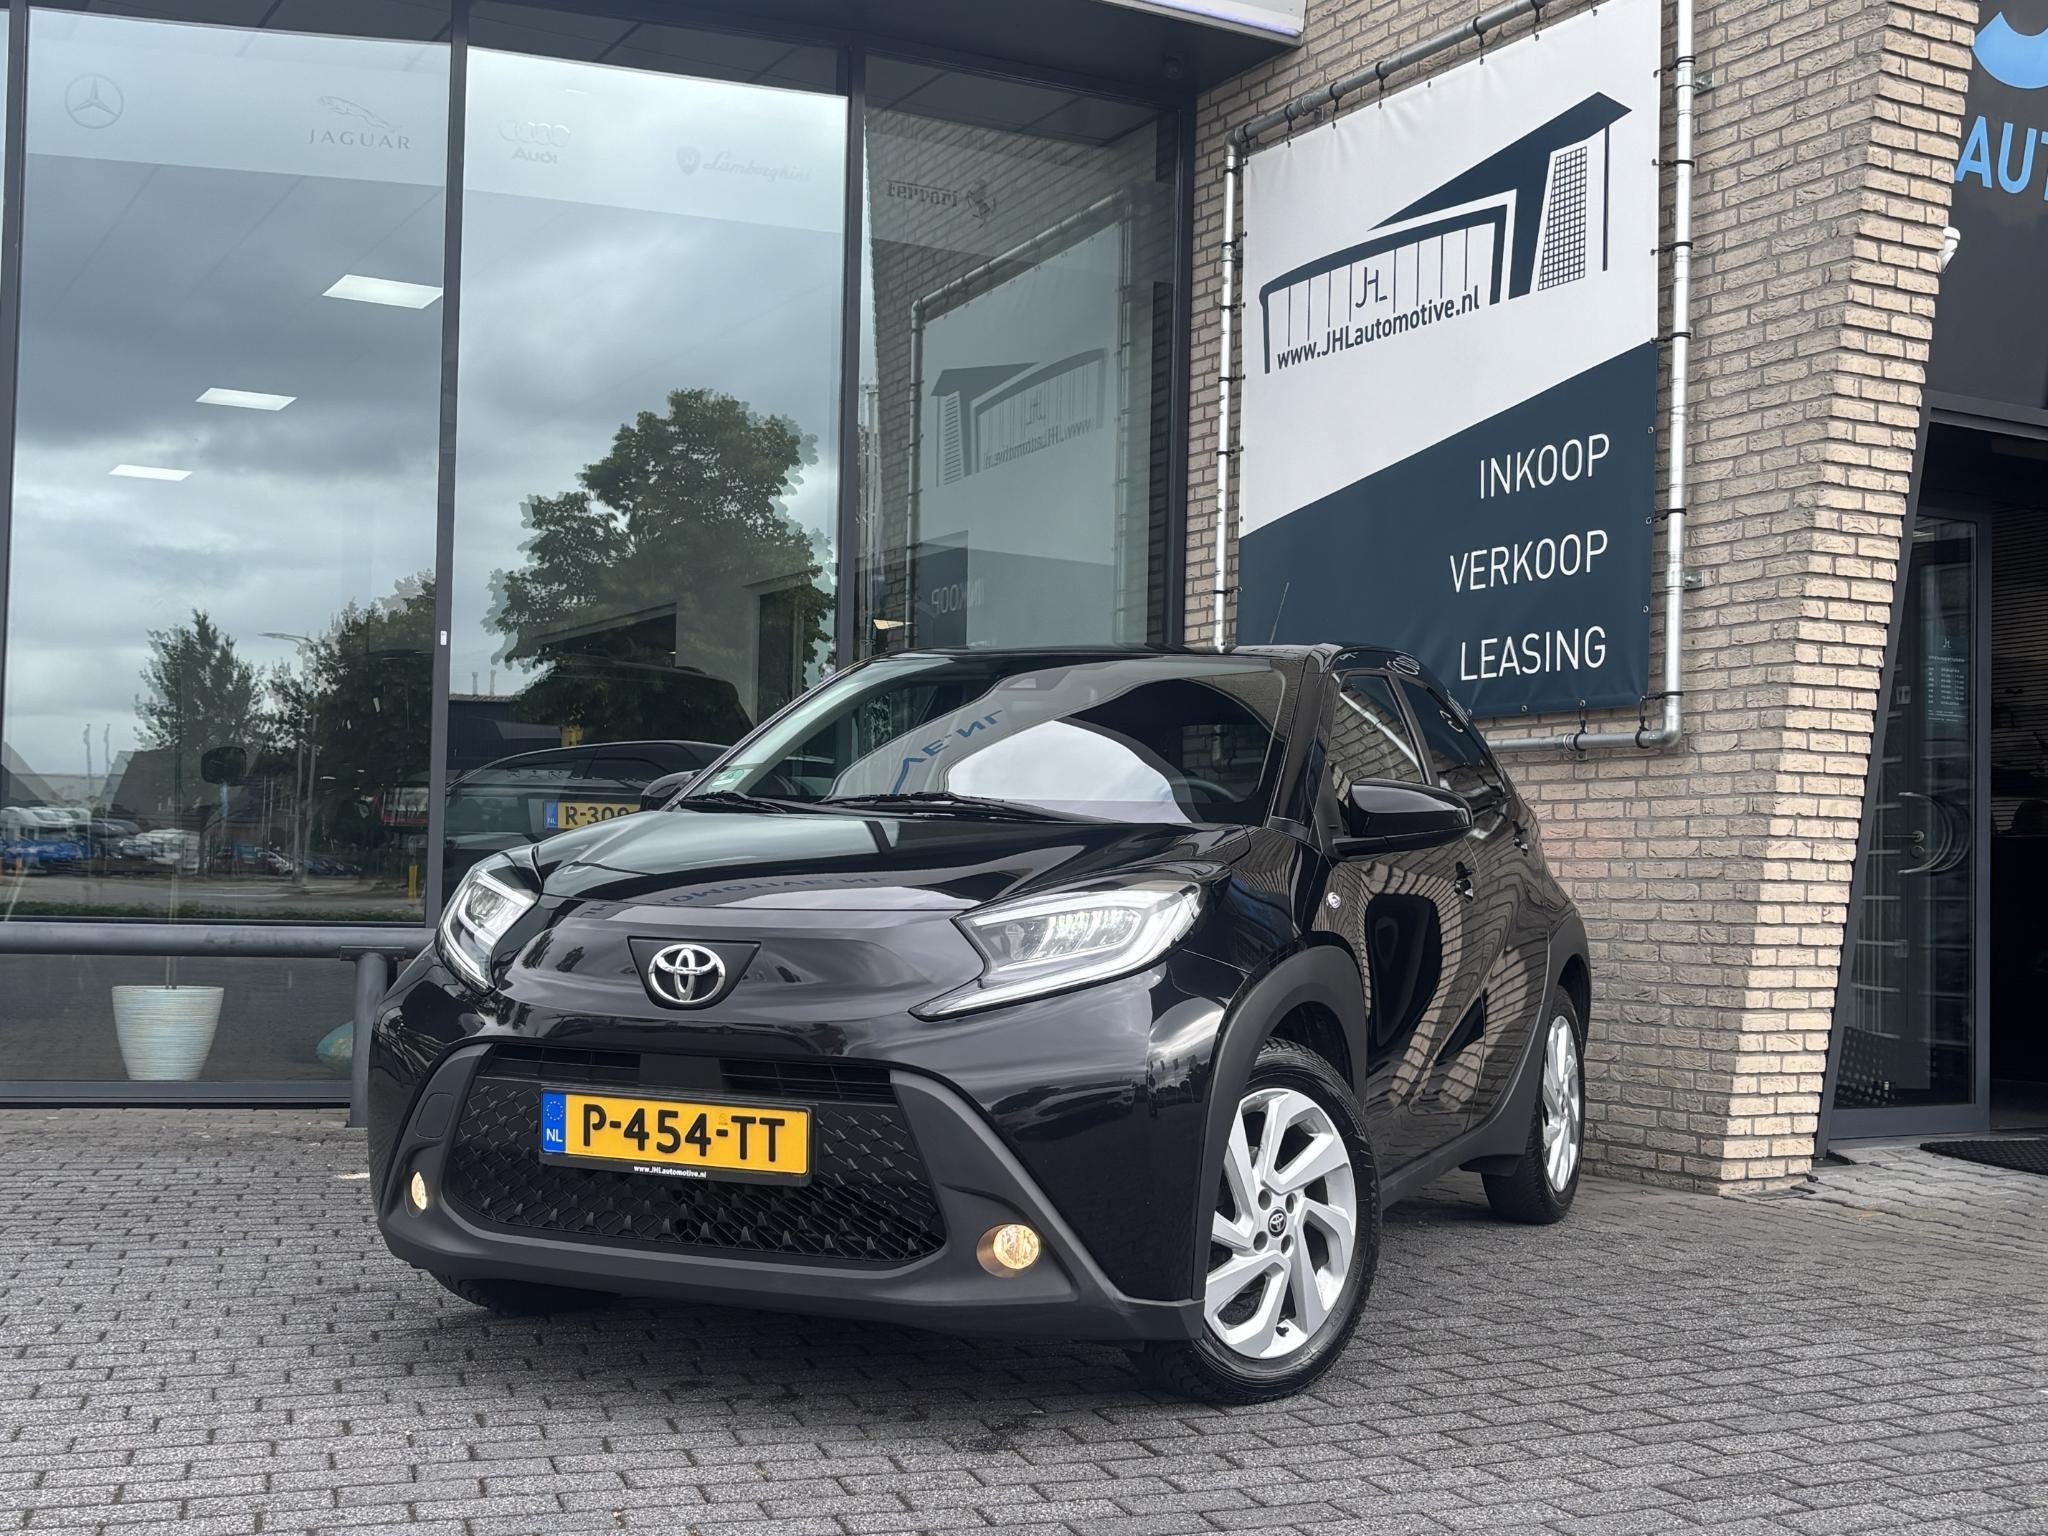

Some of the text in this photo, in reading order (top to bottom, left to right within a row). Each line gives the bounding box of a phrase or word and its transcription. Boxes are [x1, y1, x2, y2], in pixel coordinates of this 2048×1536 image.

[309, 128, 412, 150] JAGUAR
[1955, 115, 2048, 200] AU
[1276, 284, 1480, 370] www.JHLautomotive.nl
[1479, 433, 1610, 500] INKOOP
[1449, 529, 1608, 593] VERKOOP
[1460, 625, 1606, 681] LEASING
[546, 1128, 563, 1143] NL
[582, 1103, 786, 1163] P-454-TT
[633, 1165, 707, 1178] www.JHLautomotive.nl
